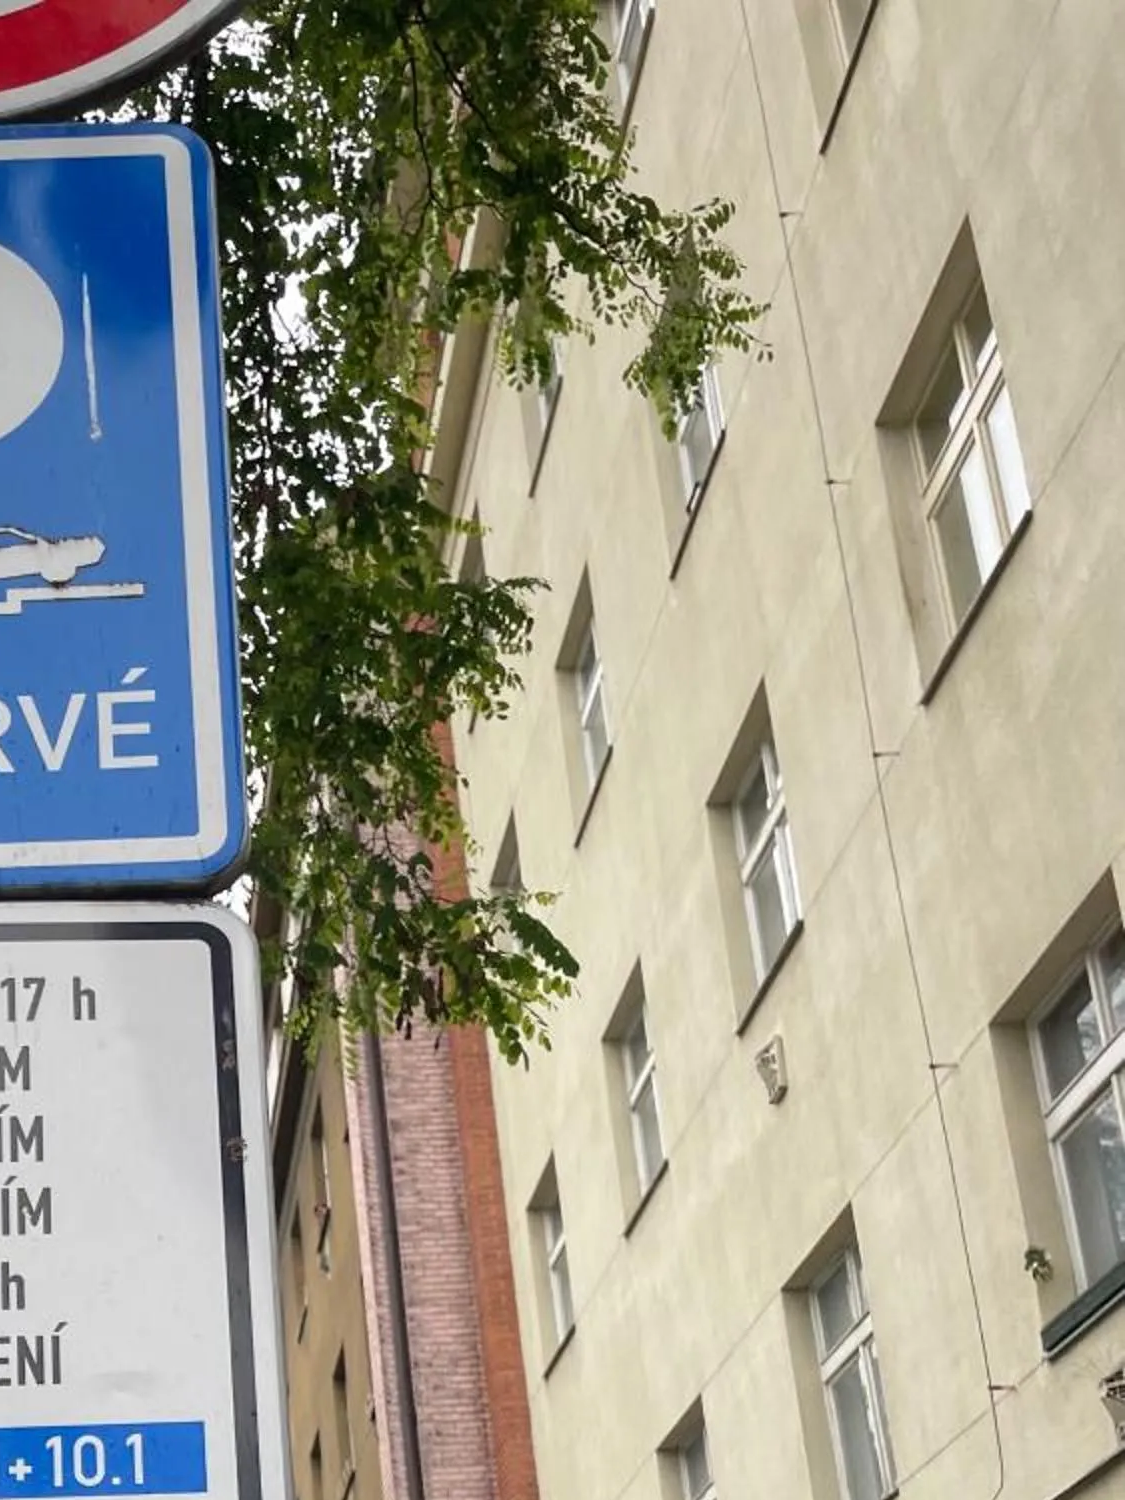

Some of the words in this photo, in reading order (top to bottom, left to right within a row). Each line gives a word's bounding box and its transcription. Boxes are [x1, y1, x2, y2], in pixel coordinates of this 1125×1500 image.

[1, 978, 45, 1021] 17
[73, 977, 95, 1020] h
[2, 1262, 25, 1310] h
